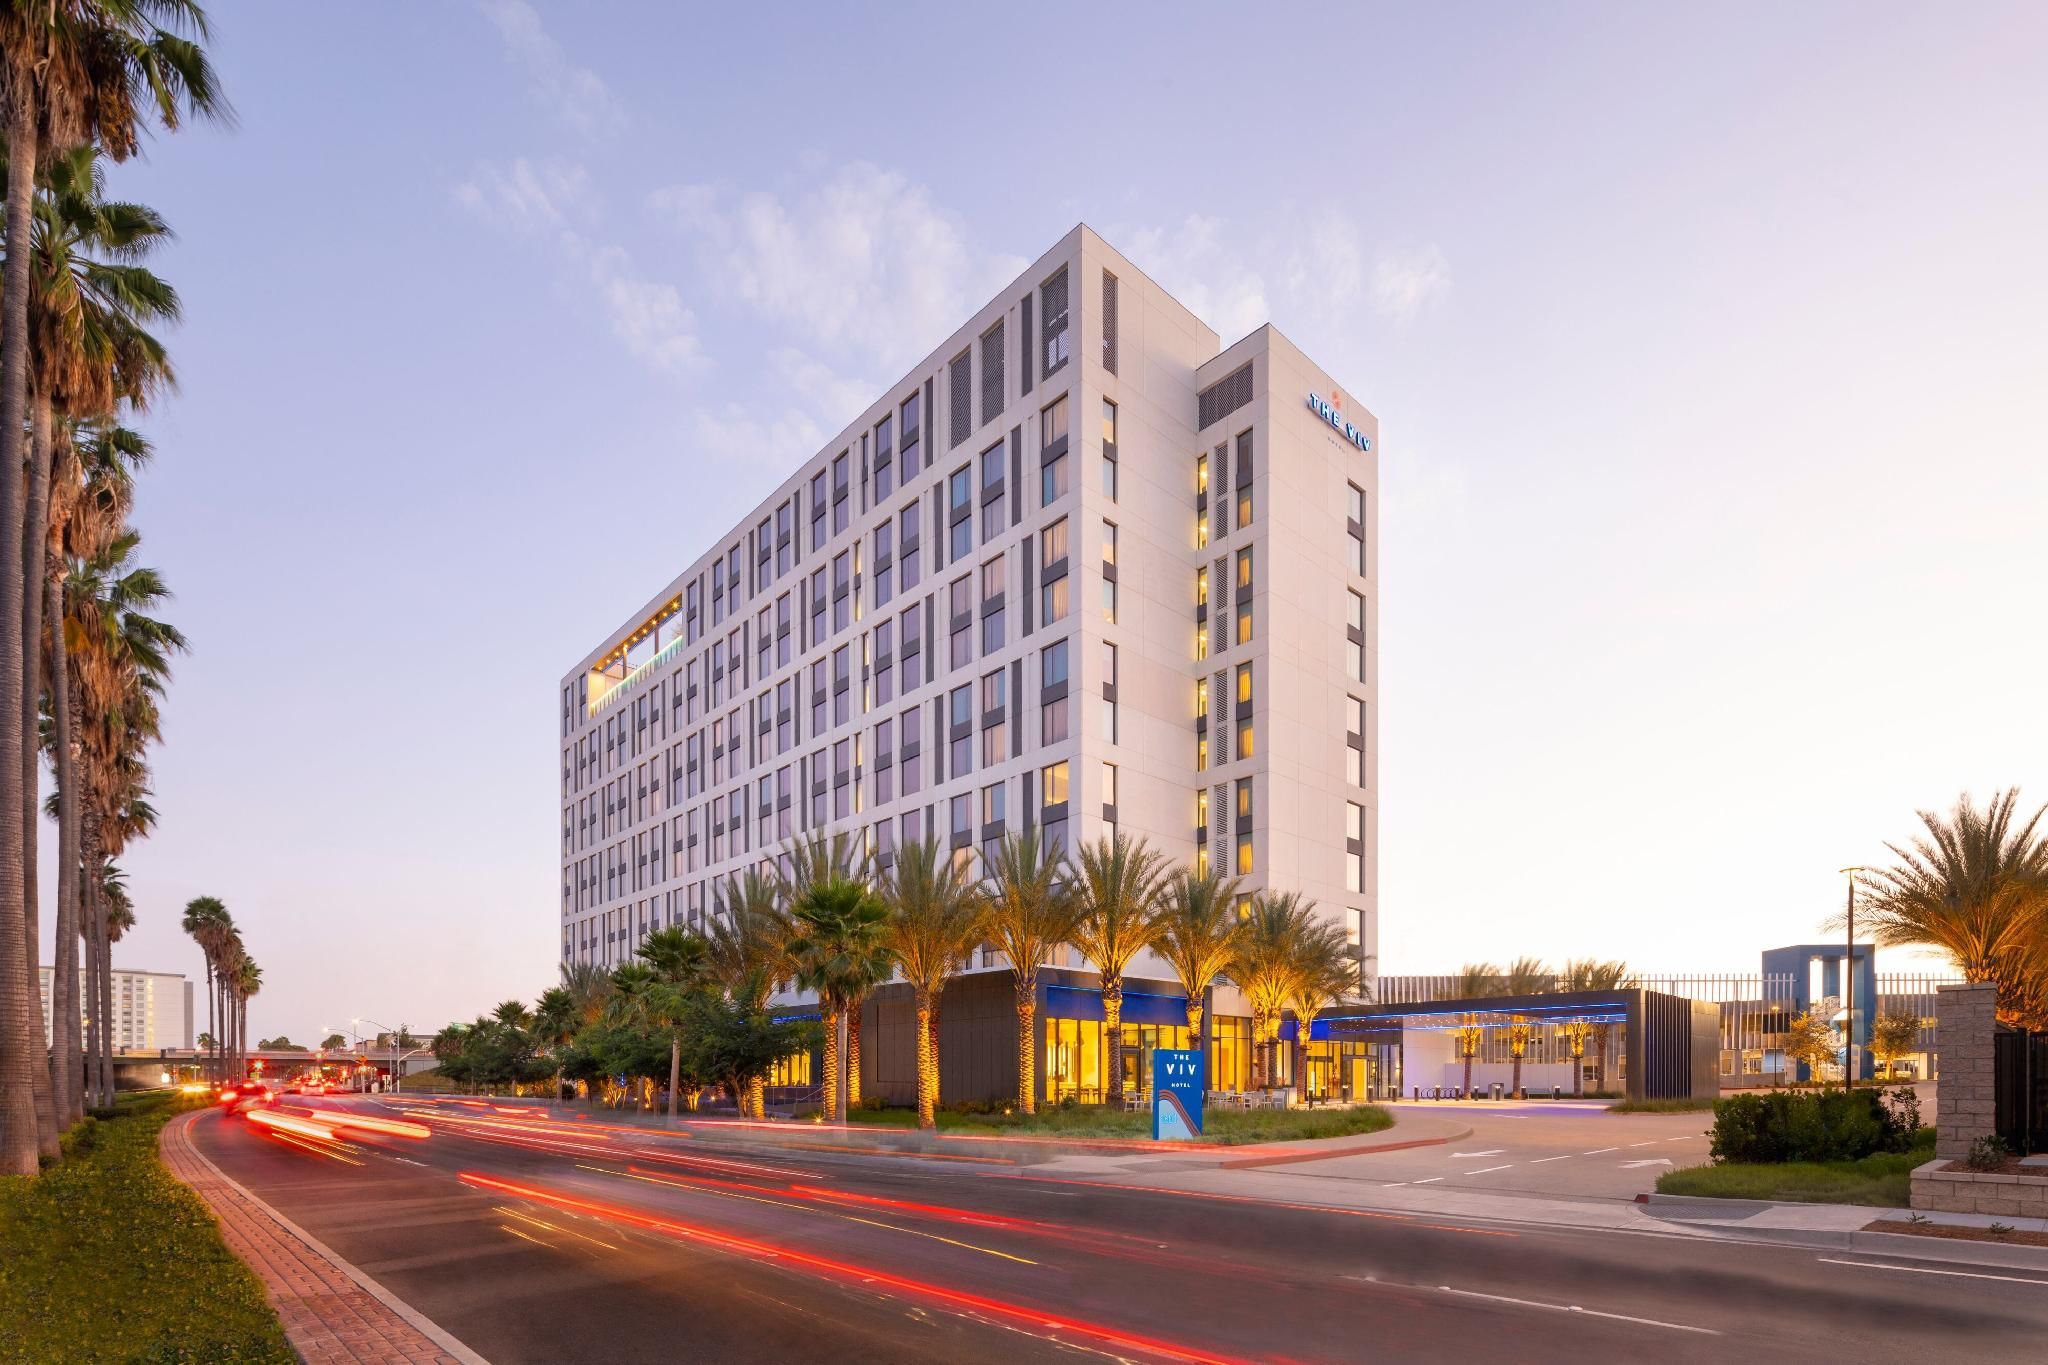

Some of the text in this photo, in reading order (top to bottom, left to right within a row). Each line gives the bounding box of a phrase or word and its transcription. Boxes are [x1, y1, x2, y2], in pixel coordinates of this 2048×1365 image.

[1310, 393, 1339, 427] THE
[1346, 423, 1370, 451] VIV
[1166, 1063, 1196, 1075] VIV
